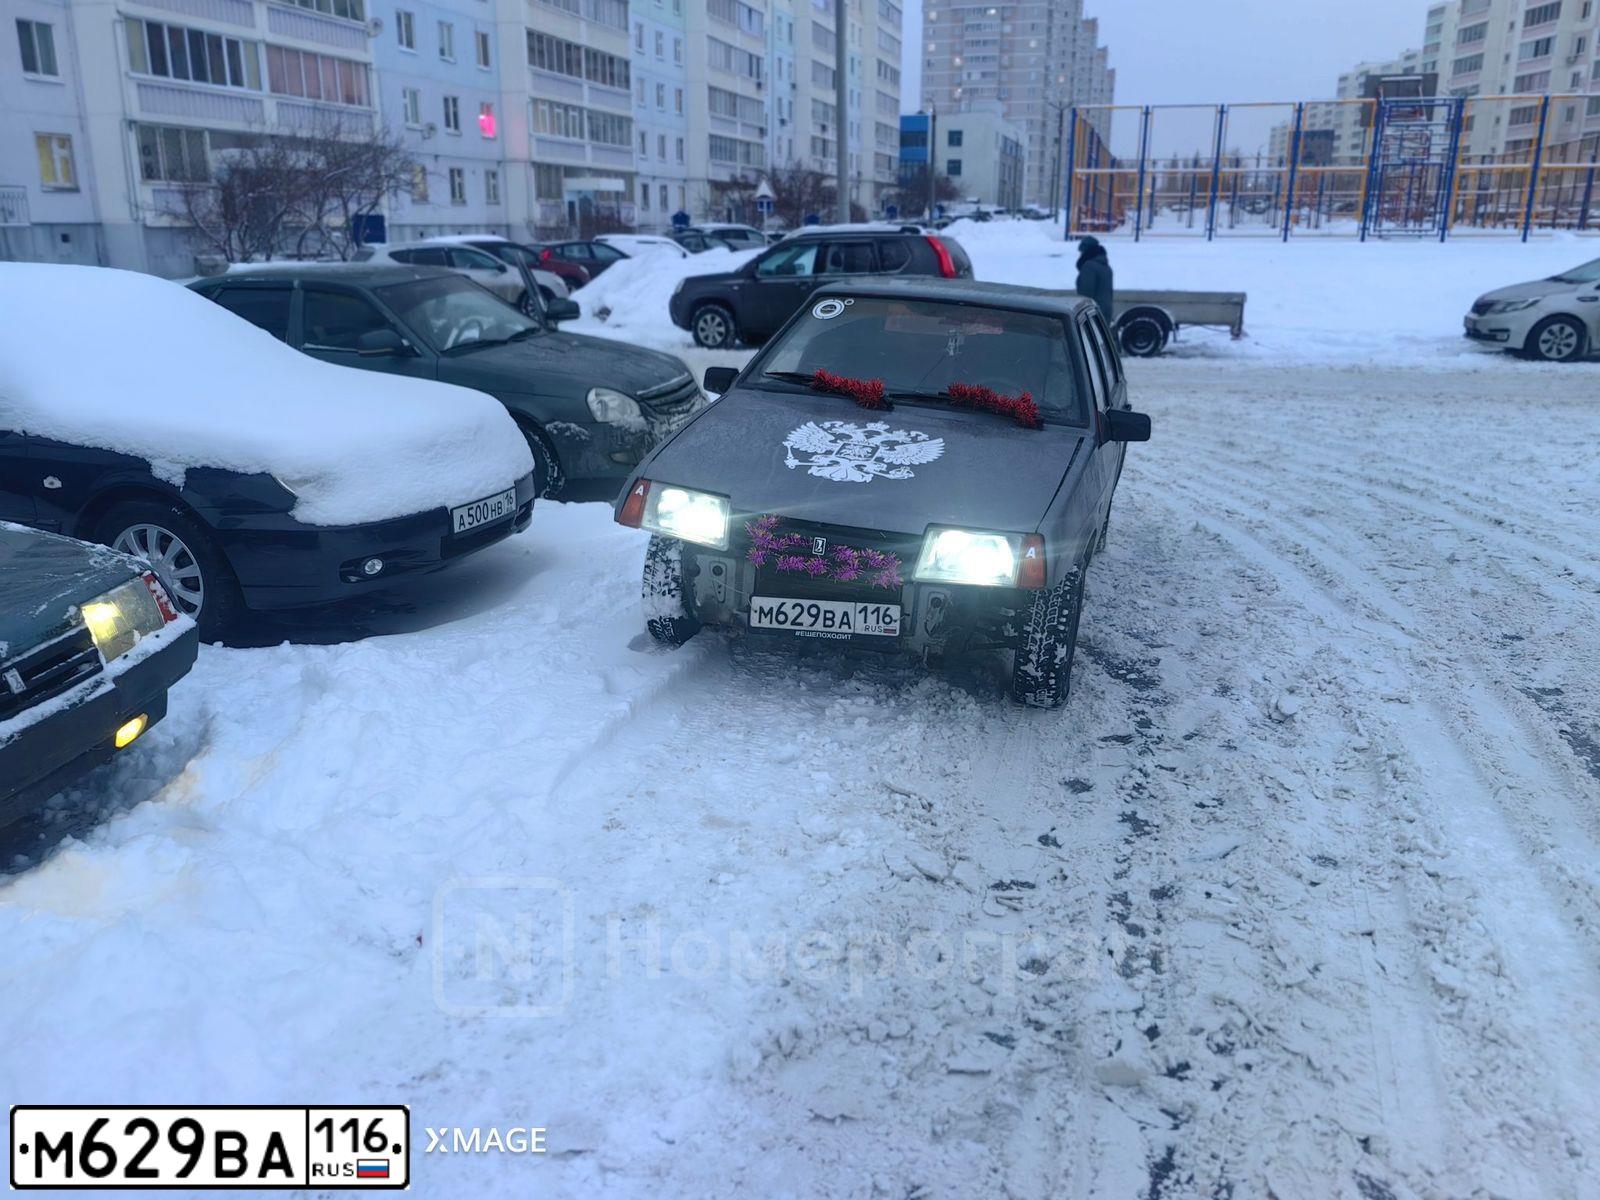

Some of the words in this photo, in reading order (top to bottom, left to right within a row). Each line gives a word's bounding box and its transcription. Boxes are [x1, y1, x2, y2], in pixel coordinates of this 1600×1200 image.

[757, 602, 852, 630] М629ВА
[858, 605, 893, 626] 116
[864, 624, 883, 633] RUS
